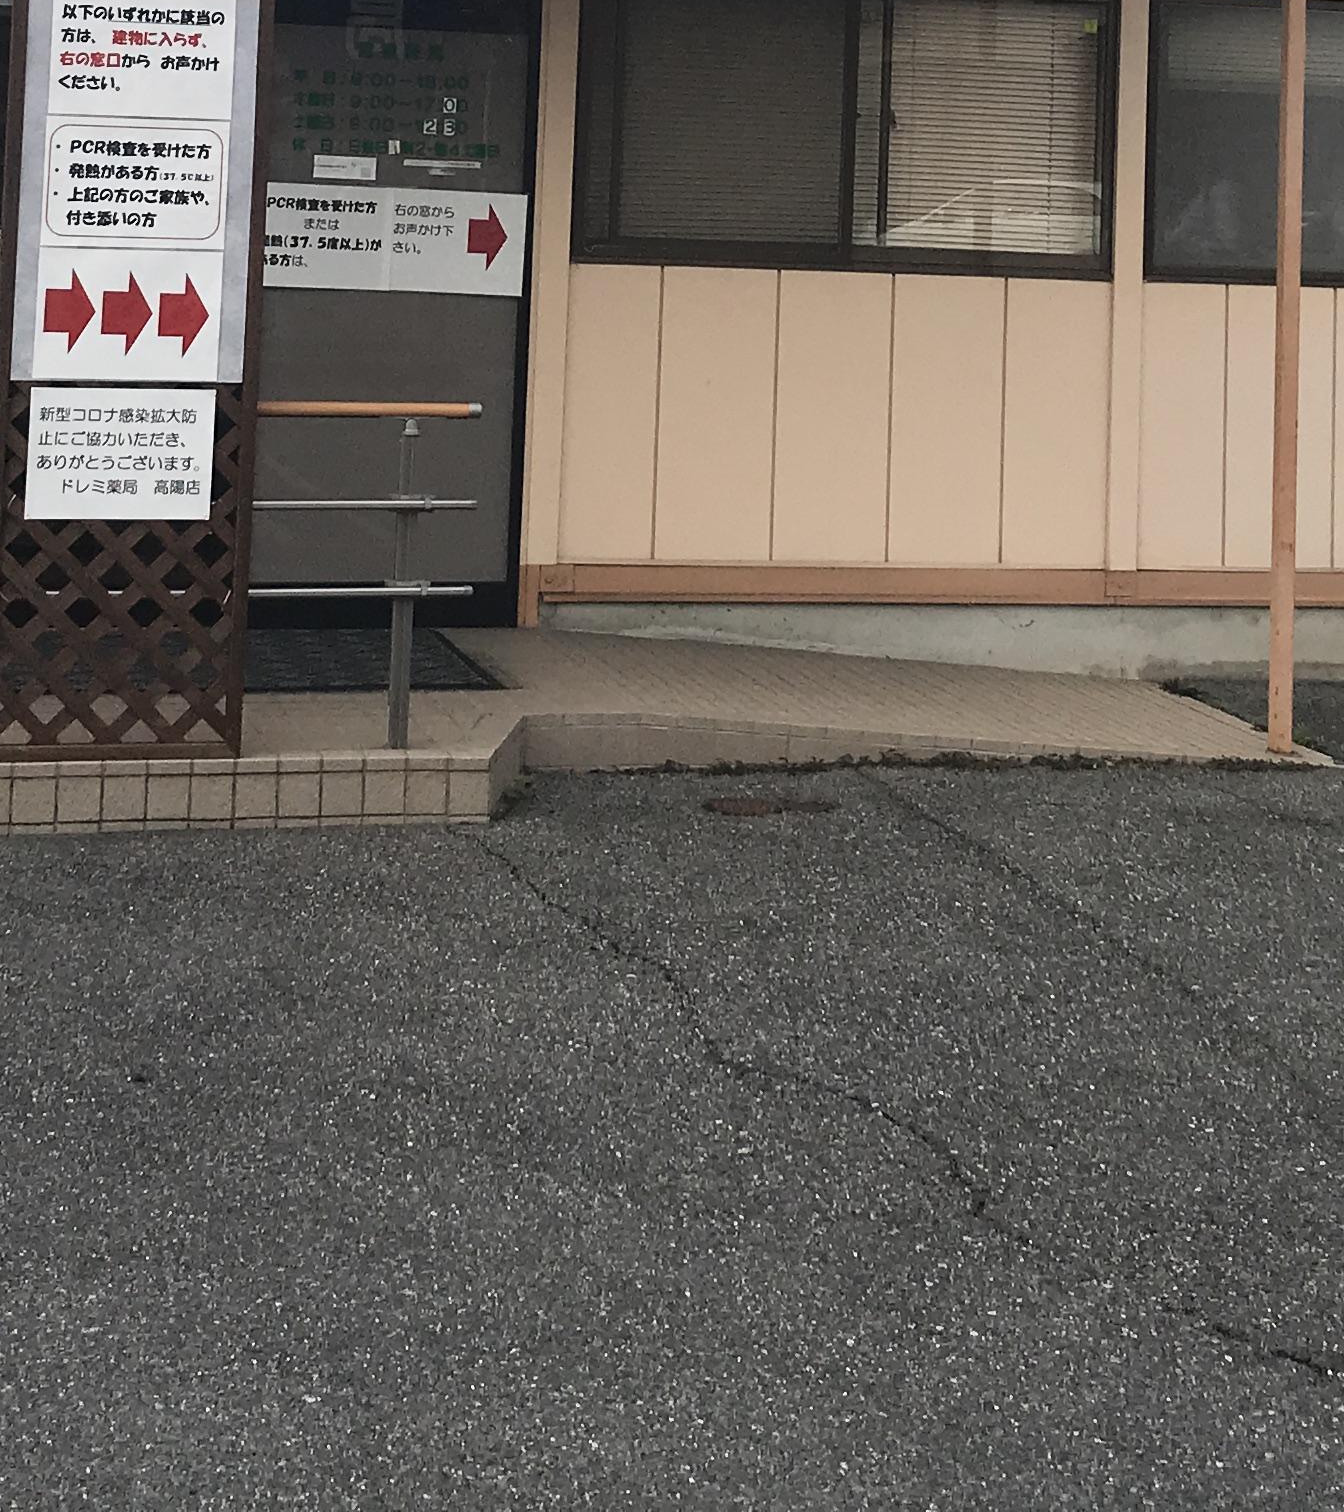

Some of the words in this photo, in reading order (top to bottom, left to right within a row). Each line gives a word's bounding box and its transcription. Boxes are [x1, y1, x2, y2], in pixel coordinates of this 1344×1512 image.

[62, 4, 225, 26] 以下のいずれかに該当の
[57, 74, 121, 92] ください。
[67, 187, 210, 206] 上記の方のご家族や、
[66, 210, 158, 228] 付き添いの方
[394, 203, 455, 219] 右の窓から
[303, 217, 340, 231] または
[393, 223, 455, 237] お声かけ下
[392, 241, 422, 255] さい。
[39, 406, 198, 425] 新型コロナ感染拡大防
[37, 430, 187, 448] 止にご協力いただき、
[36, 454, 200, 472] ありがとうございます。
[61, 479, 138, 495] ドレミ薬局
[153, 480, 201, 496] 高陽店
